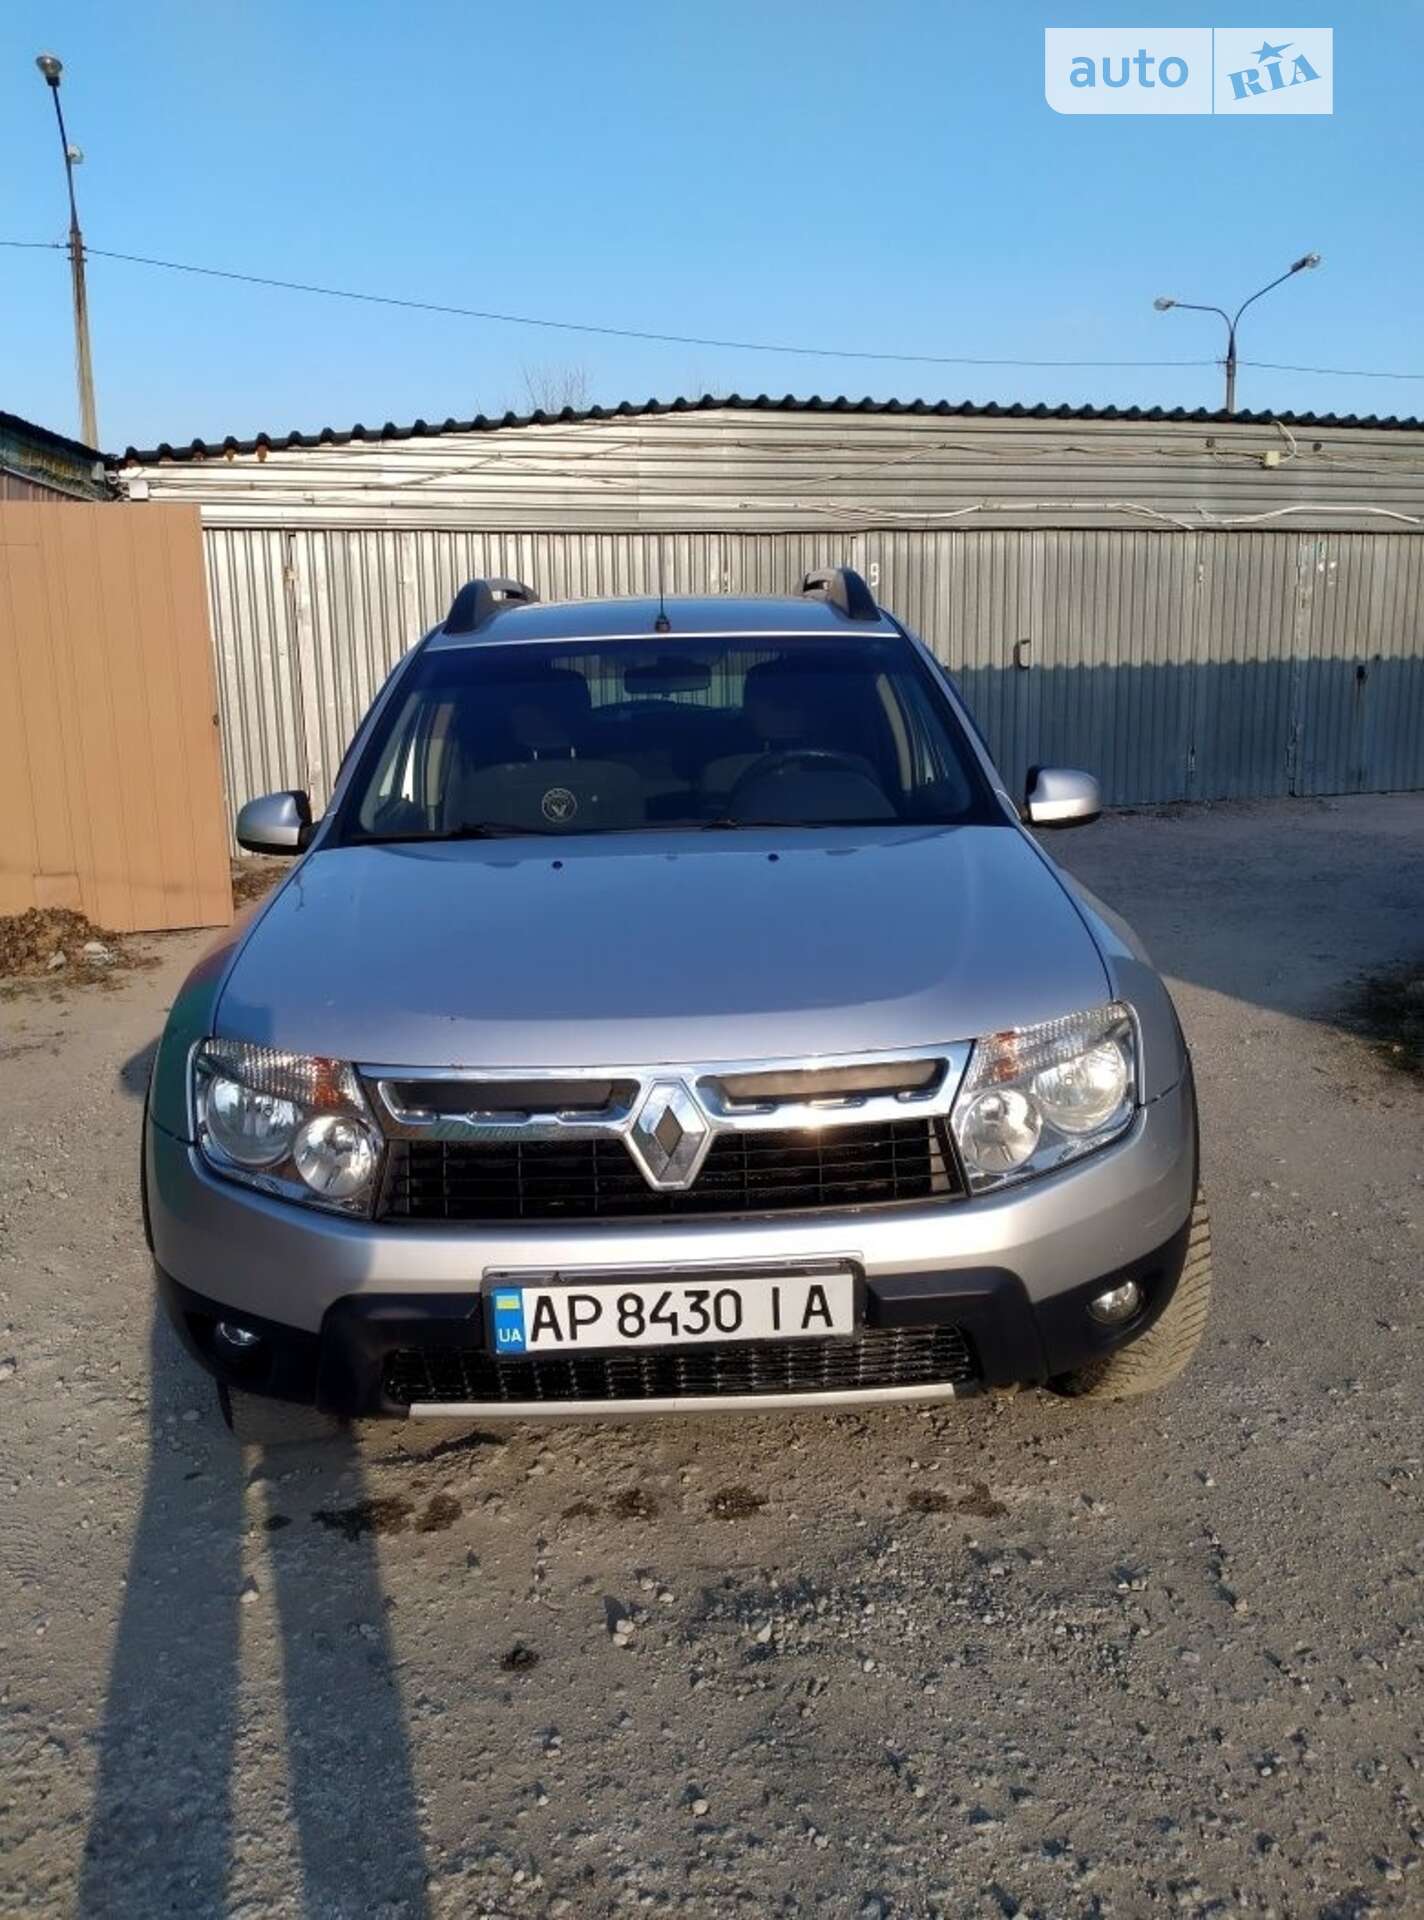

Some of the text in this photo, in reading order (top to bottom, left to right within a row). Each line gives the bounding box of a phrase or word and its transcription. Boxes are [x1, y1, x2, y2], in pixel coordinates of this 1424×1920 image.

[870, 562, 880, 587] 9
[530, 1294, 602, 1342] AP
[616, 1287, 743, 1338] 8430
[497, 1327, 522, 1343] UA
